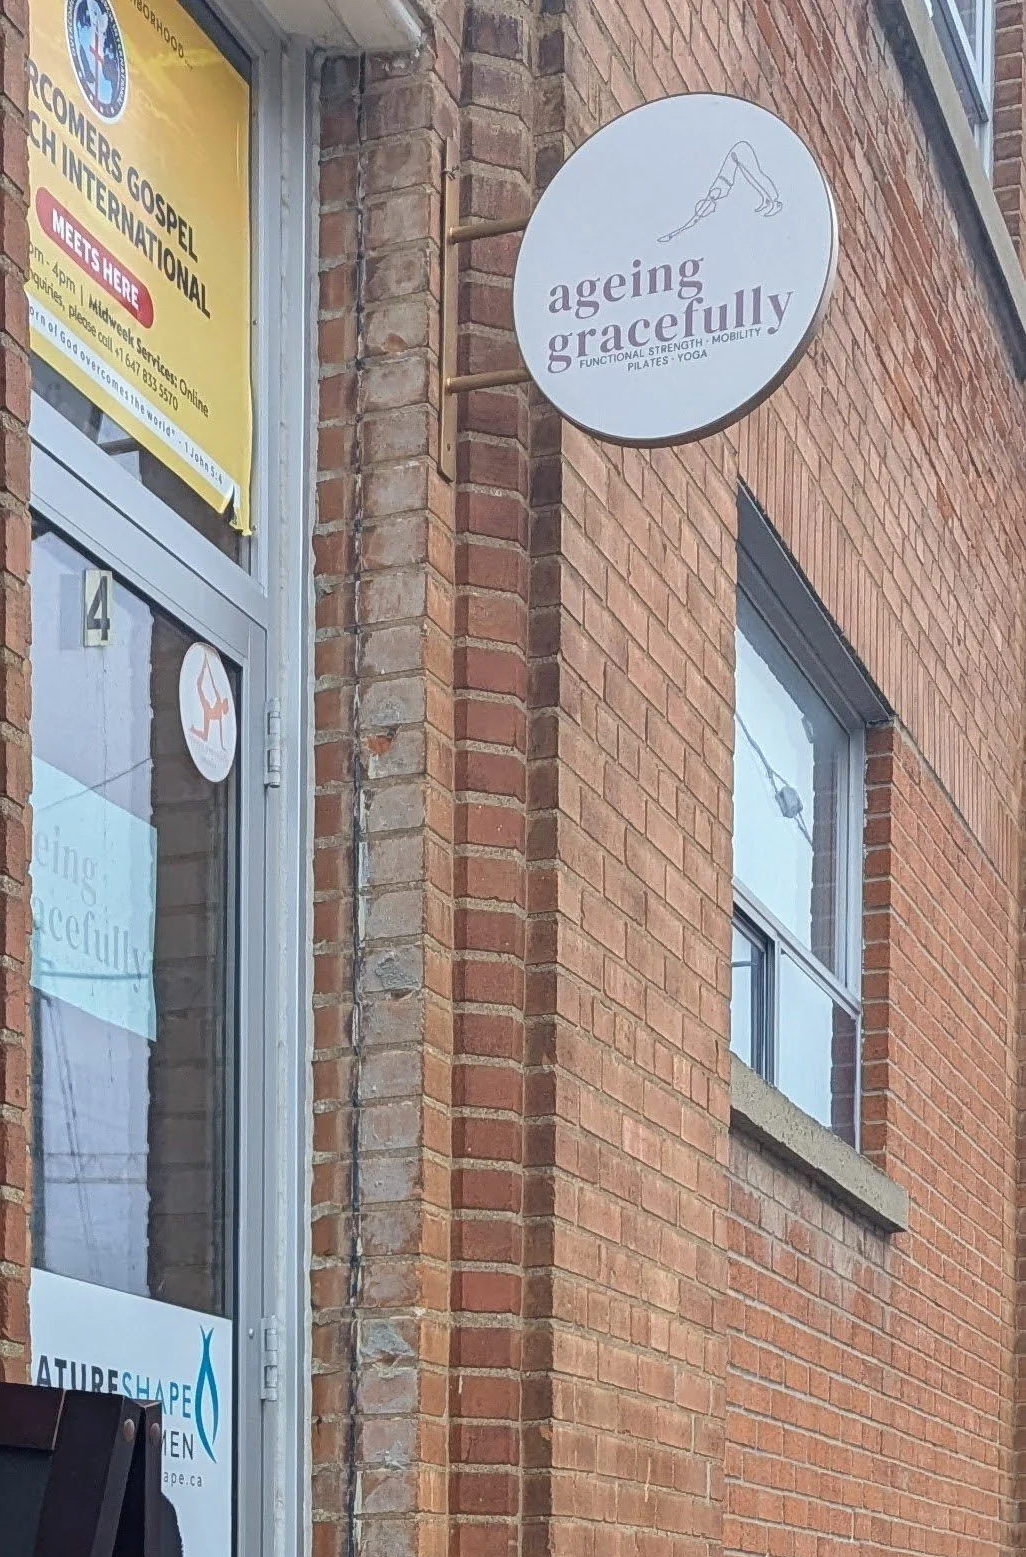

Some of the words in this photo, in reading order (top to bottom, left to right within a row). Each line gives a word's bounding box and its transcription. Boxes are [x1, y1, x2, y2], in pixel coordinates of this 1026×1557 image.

[29, 110, 55, 165] CH
[62, 141, 210, 319] INTERNATIONAL
[52, 207, 100, 272] MEETS
[102, 257, 139, 311] HERE
[127, 166, 198, 263] GOSPEL
[546, 286, 794, 374] gracefully
[548, 256, 704, 319] ageing
[52, 261, 75, 294] 4pm
[89, 294, 134, 348] Midweek
[136, 337, 178, 388] Services:
[179, 379, 209, 418] Online
[68, 304, 96, 337] please
[98, 332, 113, 353] call
[115, 347, 123, 361] +1
[125, 353, 141, 376] 647
[142, 368, 157, 391] 833
[159, 383, 179, 411] 5570
[579, 349, 645, 369] FUNCTIONAL
[648, 338, 703, 356] STRENGTH
[711, 327, 762, 345] MOBILITY
[627, 355, 669, 372] PILATES
[678, 350, 708, 363] YOGA
[59, 331, 78, 355] God
[80, 350, 129, 400] overcomes
[130, 394, 145, 415] the
[190, 448, 209, 472] John
[210, 466, 223, 485] 5:4
[86, 575, 111, 641] 4
